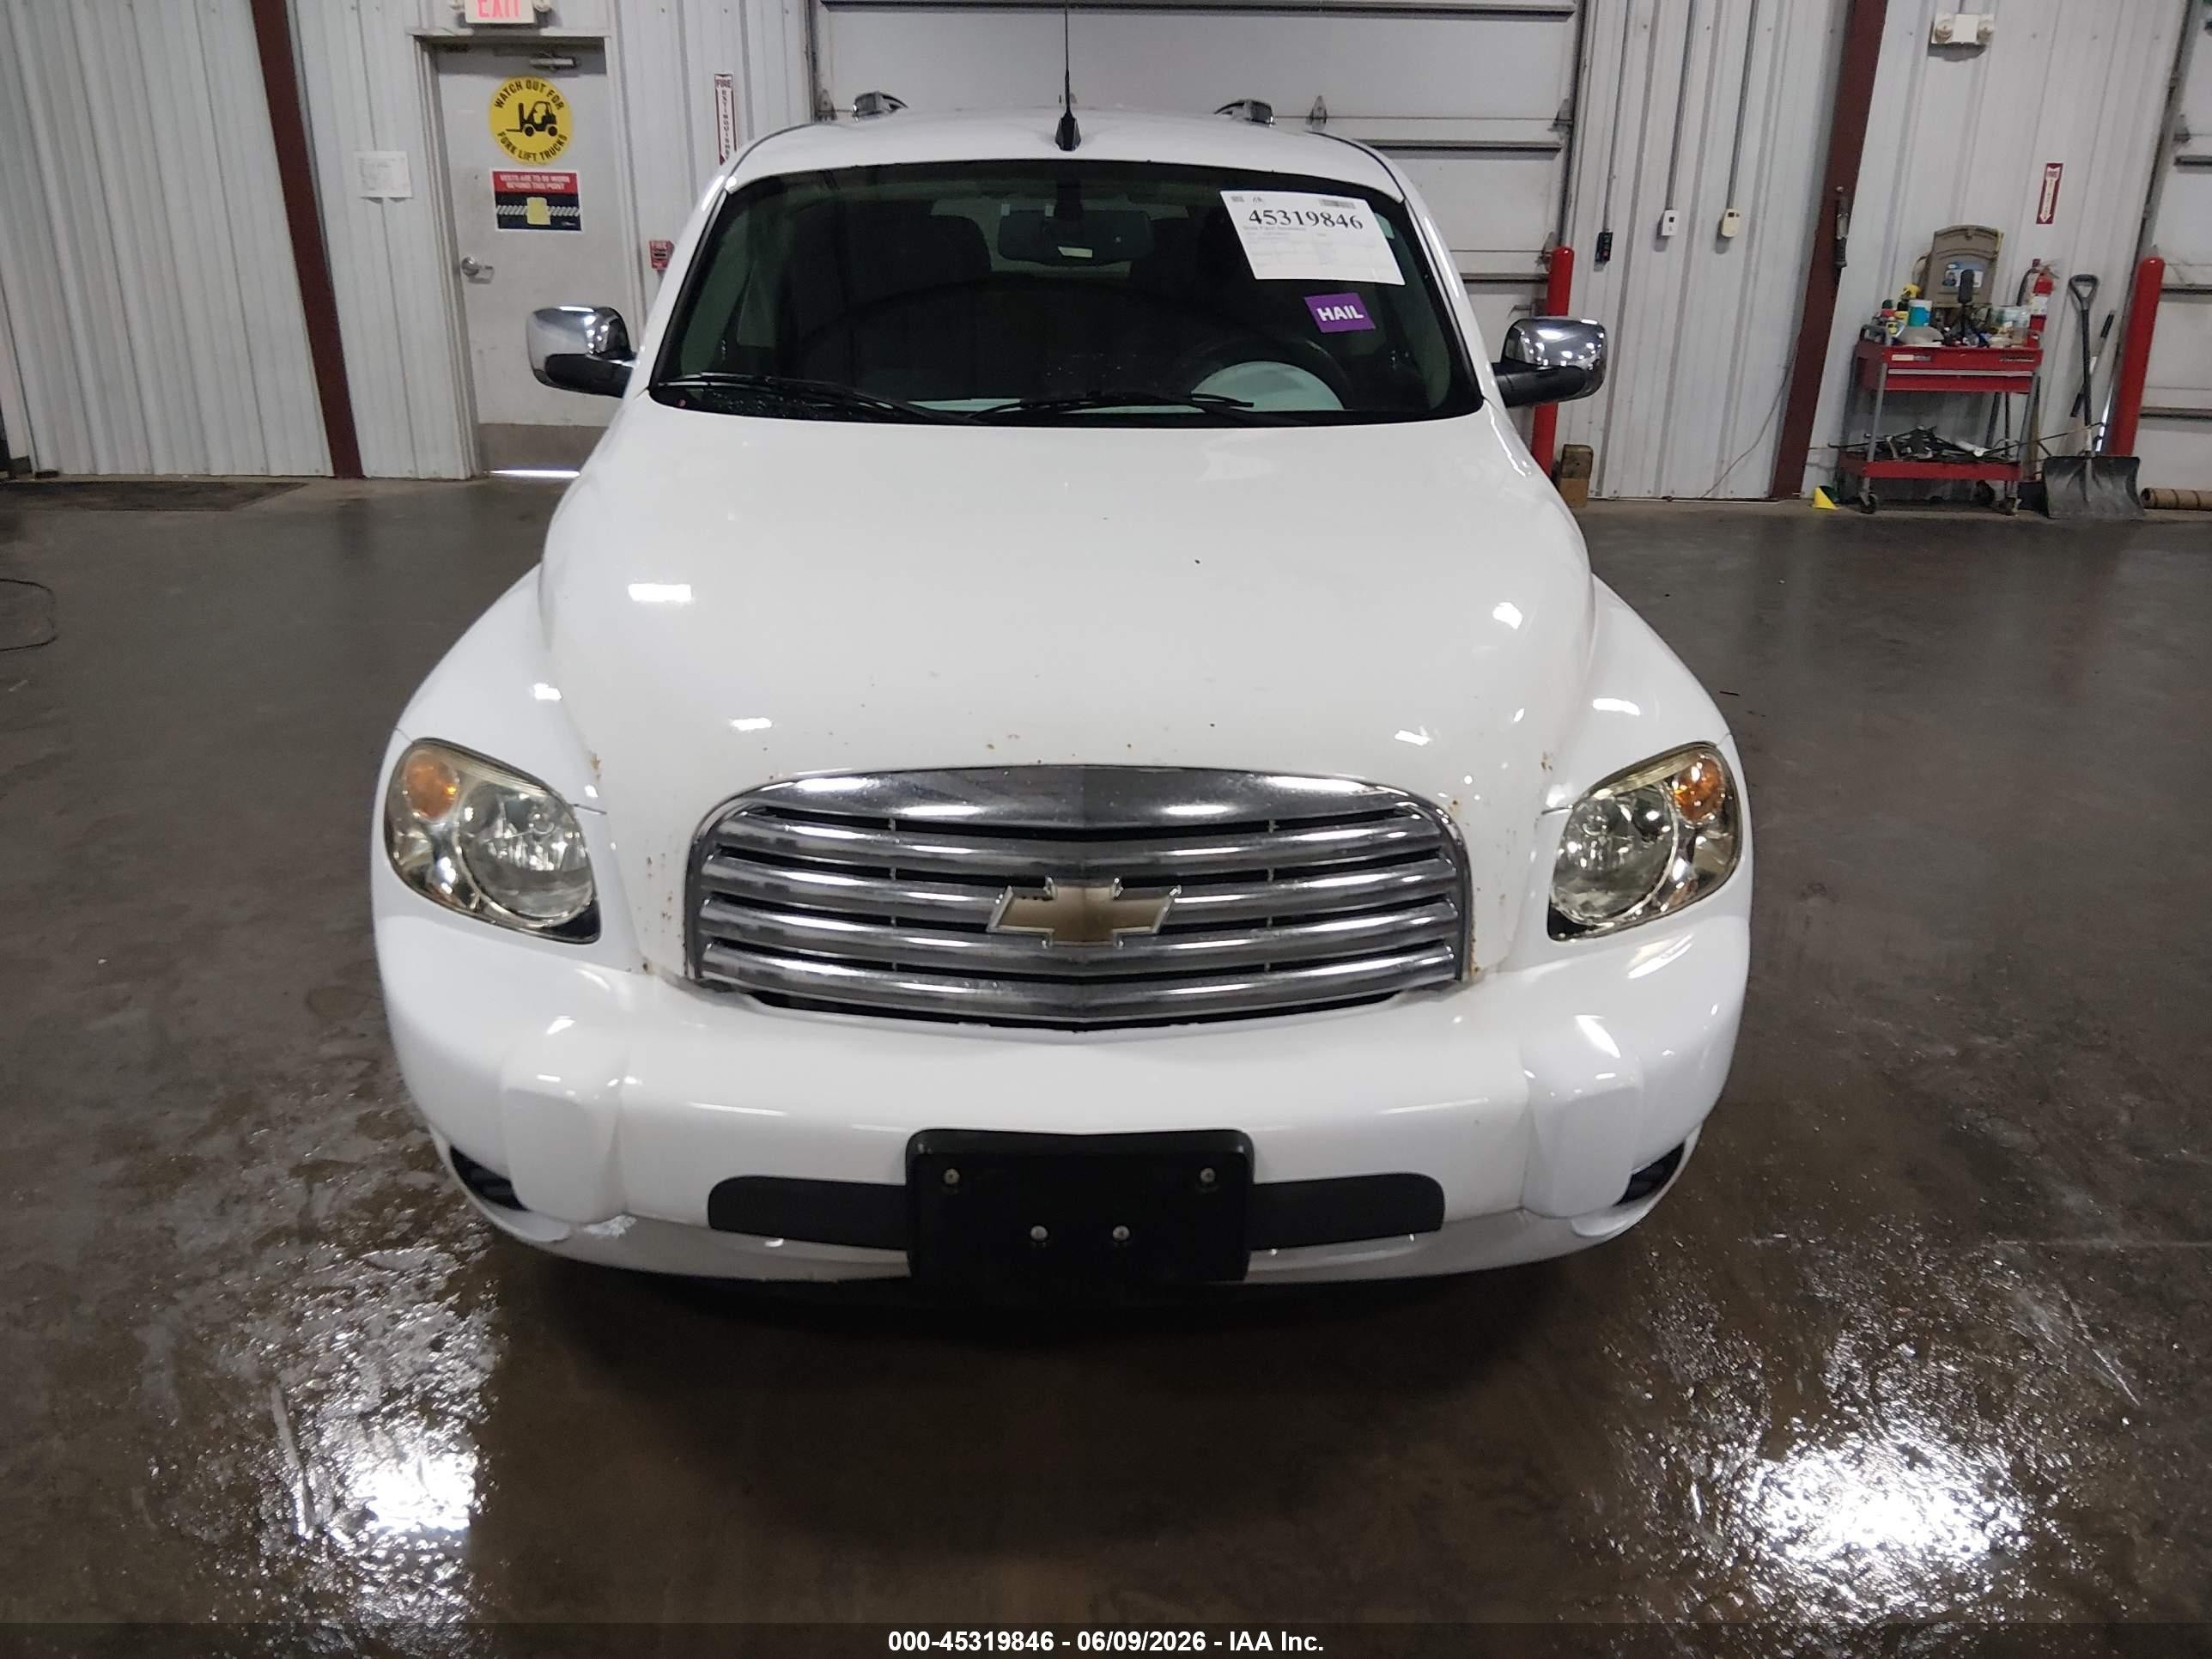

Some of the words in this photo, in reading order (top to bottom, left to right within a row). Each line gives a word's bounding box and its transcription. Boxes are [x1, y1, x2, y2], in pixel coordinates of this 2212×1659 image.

[494, 81, 524, 109] WATCH
[526, 79, 546, 94] OUT
[546, 89, 565, 110] FOR
[497, 131, 518, 155] FORK
[518, 150, 538, 161] LIFT
[539, 134, 568, 161] TRUCKS
[1248, 209, 1364, 230] 45319846
[1316, 304, 1364, 322] HAIL
